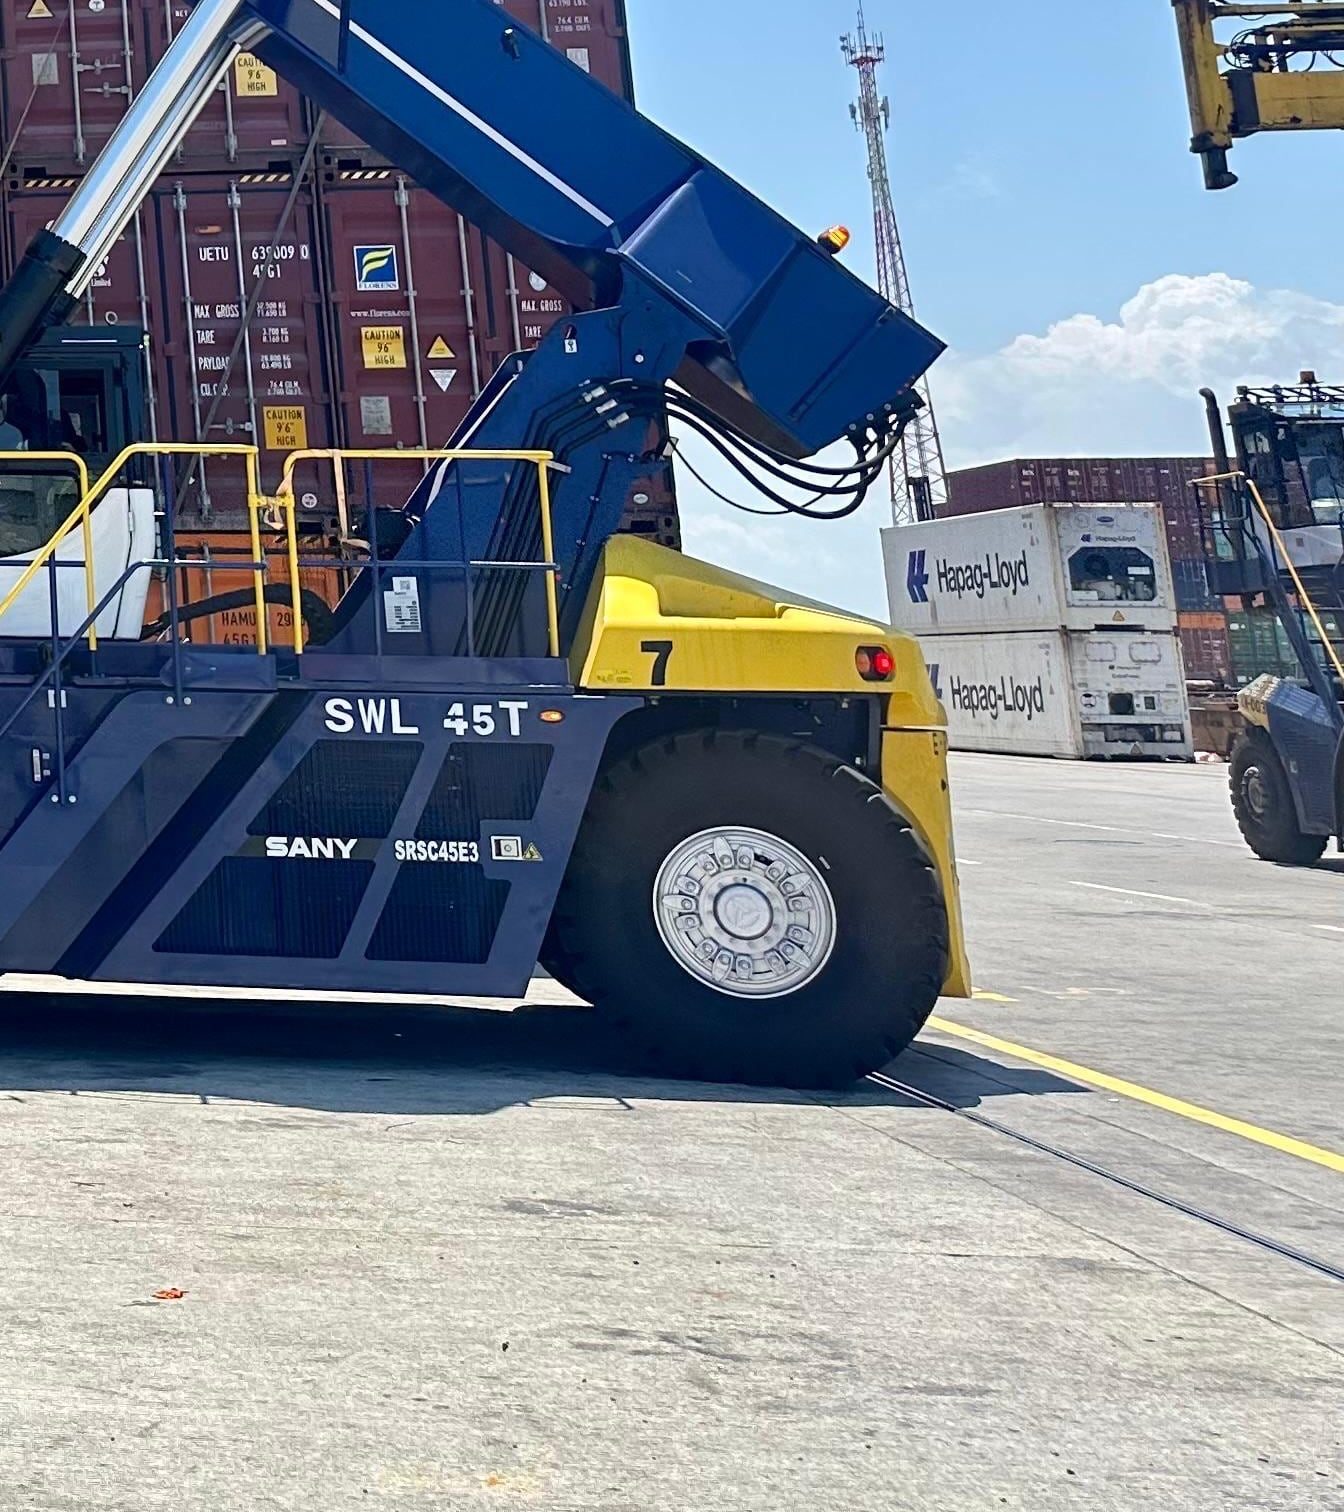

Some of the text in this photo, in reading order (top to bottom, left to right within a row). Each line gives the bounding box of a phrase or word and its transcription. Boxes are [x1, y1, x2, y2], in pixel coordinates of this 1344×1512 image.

[199, 247, 229, 261] UETU
[266, 409, 303, 420] CAUTION
[276, 435, 296, 446] HIGH
[936, 550, 1029, 600] Hapag-Lloyd
[640, 640, 673, 686] 7
[950, 674, 1046, 721] Hapag-Lloyd
[324, 698, 529, 737] SWL 45T
[265, 836, 480, 864] SANY SRSC45E3
